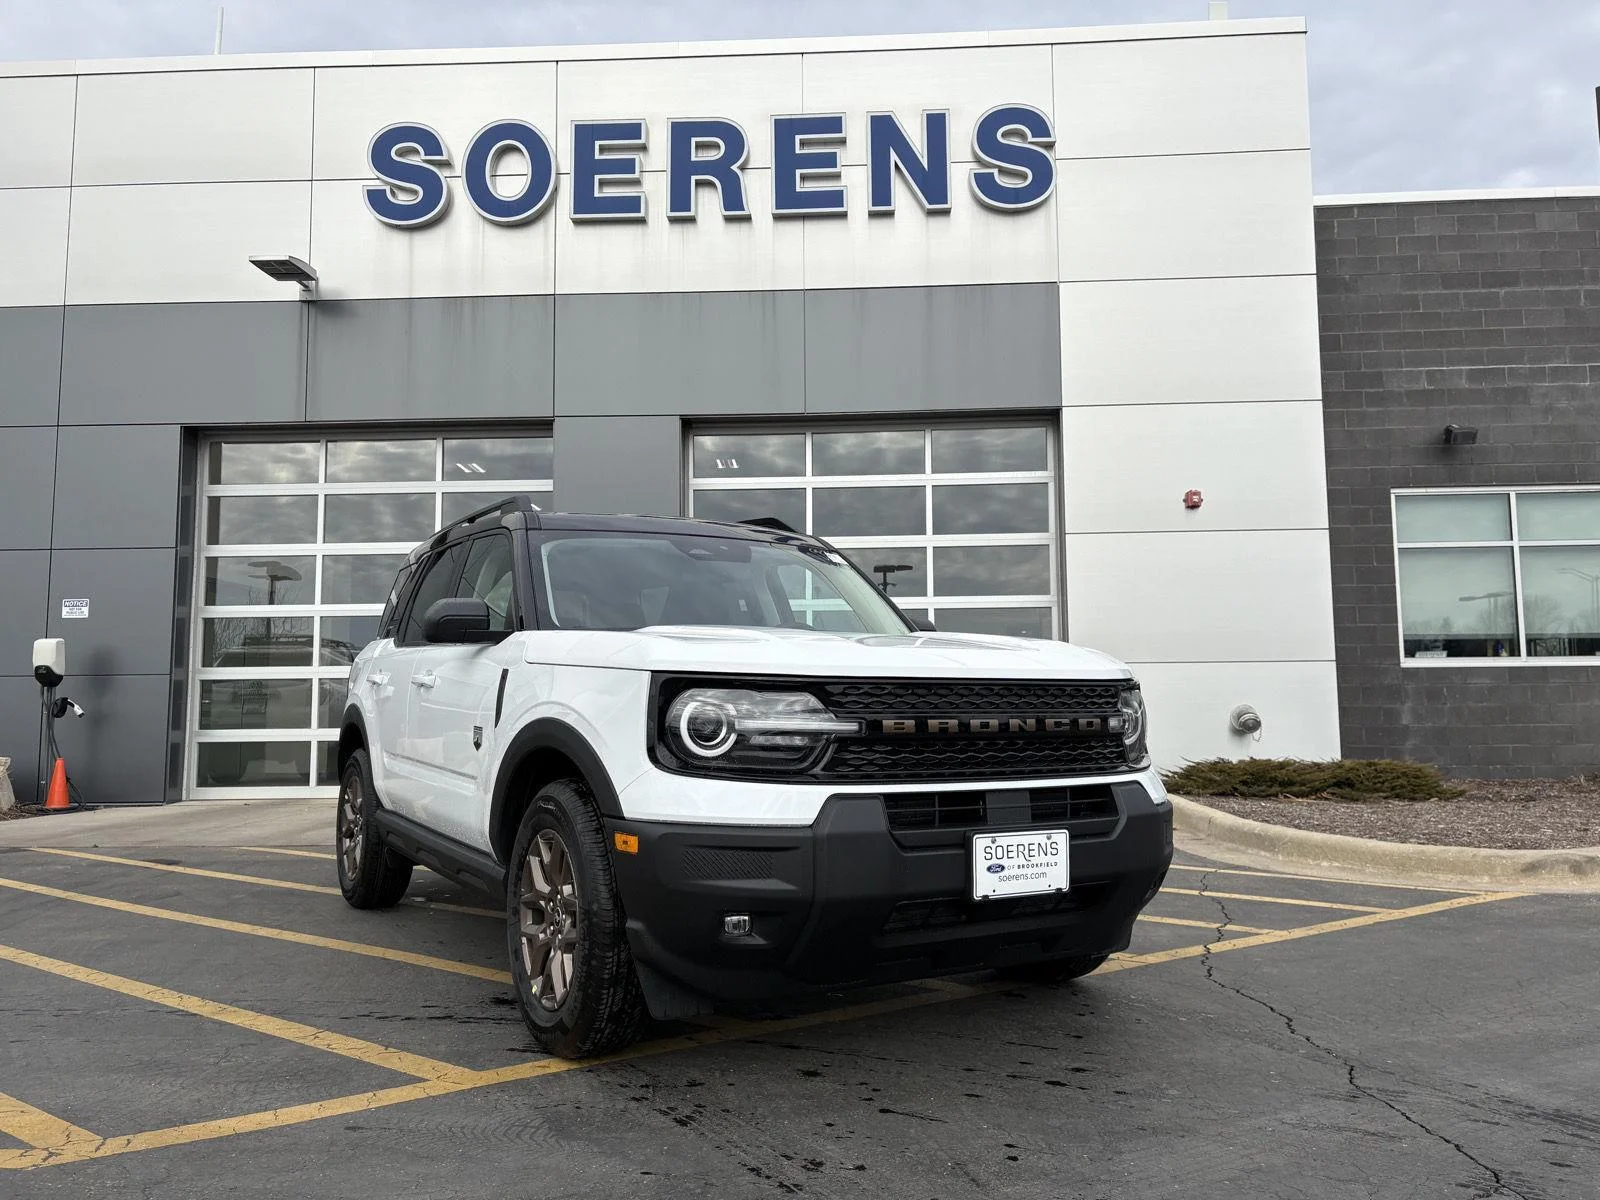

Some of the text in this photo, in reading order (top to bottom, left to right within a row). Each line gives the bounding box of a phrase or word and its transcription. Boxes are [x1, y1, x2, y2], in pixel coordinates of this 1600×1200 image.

[362, 103, 1058, 228] SOERENS
[882, 718, 1101, 733] BRONCO
[984, 841, 1059, 861] SOERENS
[988, 864, 1004, 873] Ford
[998, 871, 1047, 882] soerens.com
